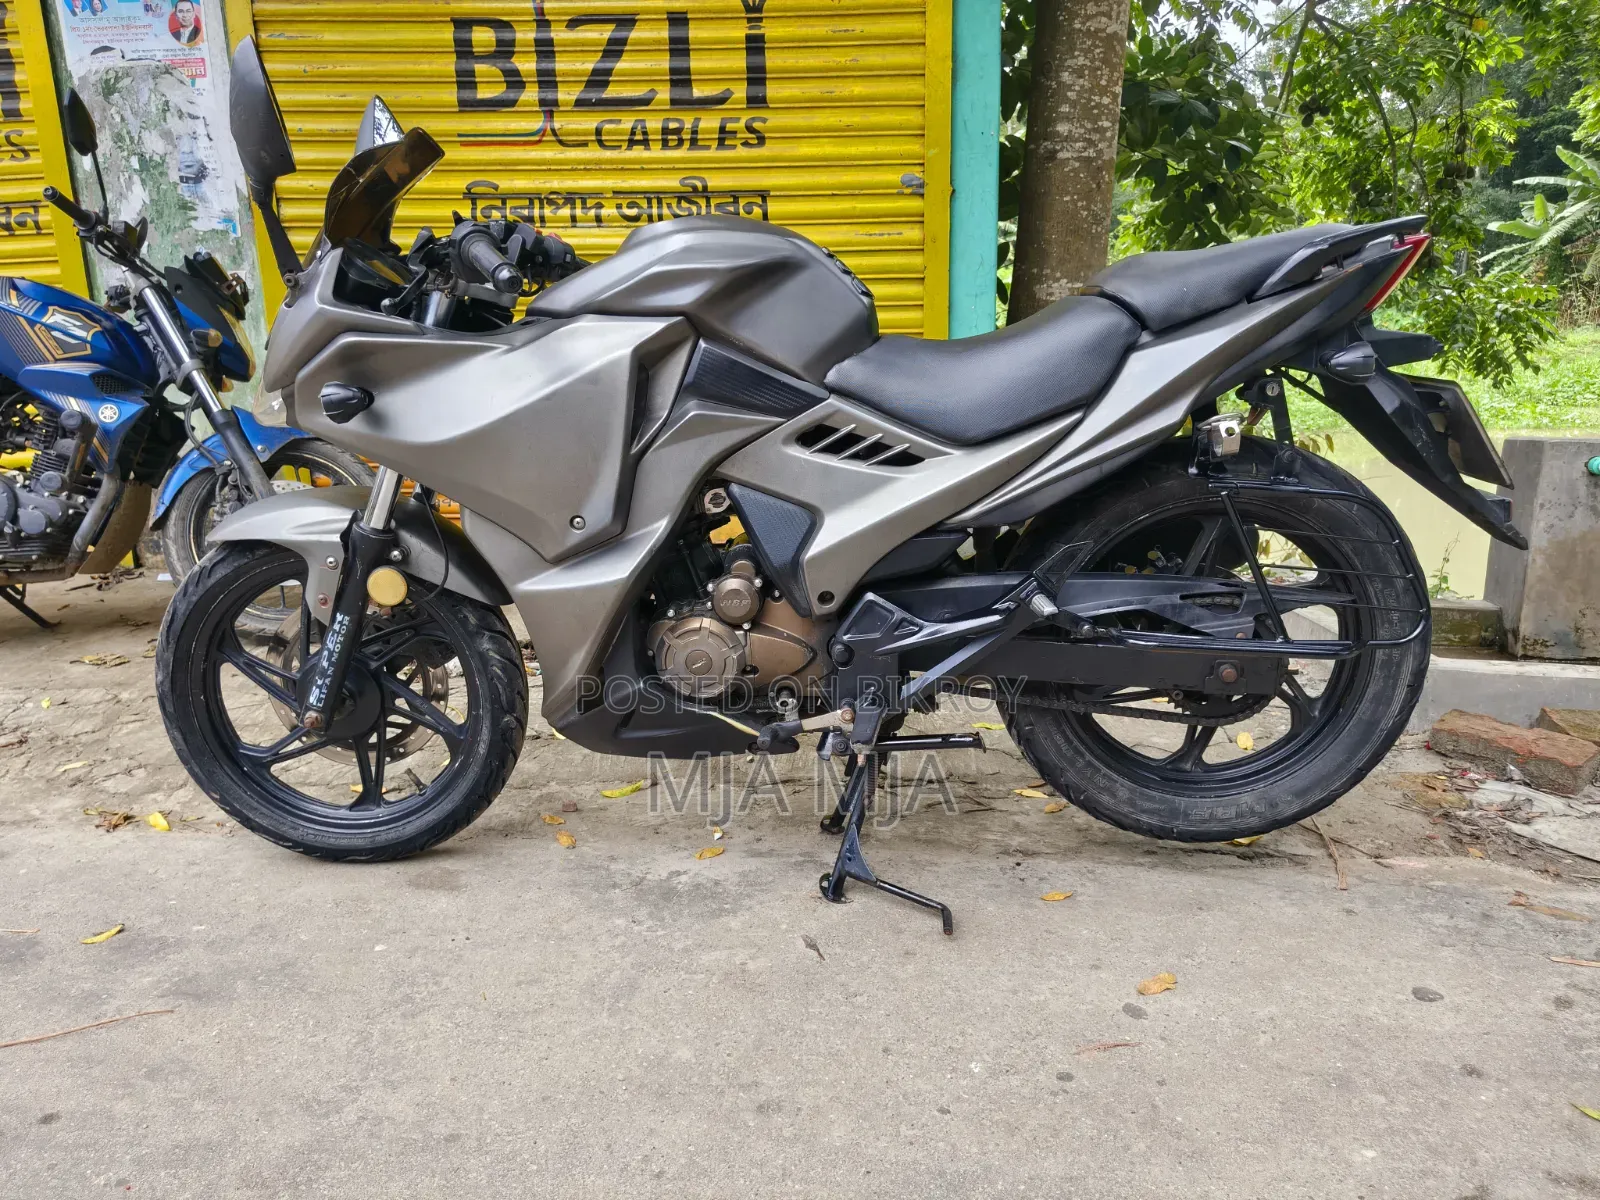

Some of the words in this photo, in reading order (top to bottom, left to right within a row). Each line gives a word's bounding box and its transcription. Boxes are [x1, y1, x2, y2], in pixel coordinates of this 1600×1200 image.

[450, 1, 769, 111] BIZLI
[595, 116, 769, 152] CABLES
[463, 179, 604, 228] নিরাপদ
[612, 175, 771, 229] আজীবন
[317, 667, 335, 708] LIFAN
[331, 615, 350, 662] MOTOR
